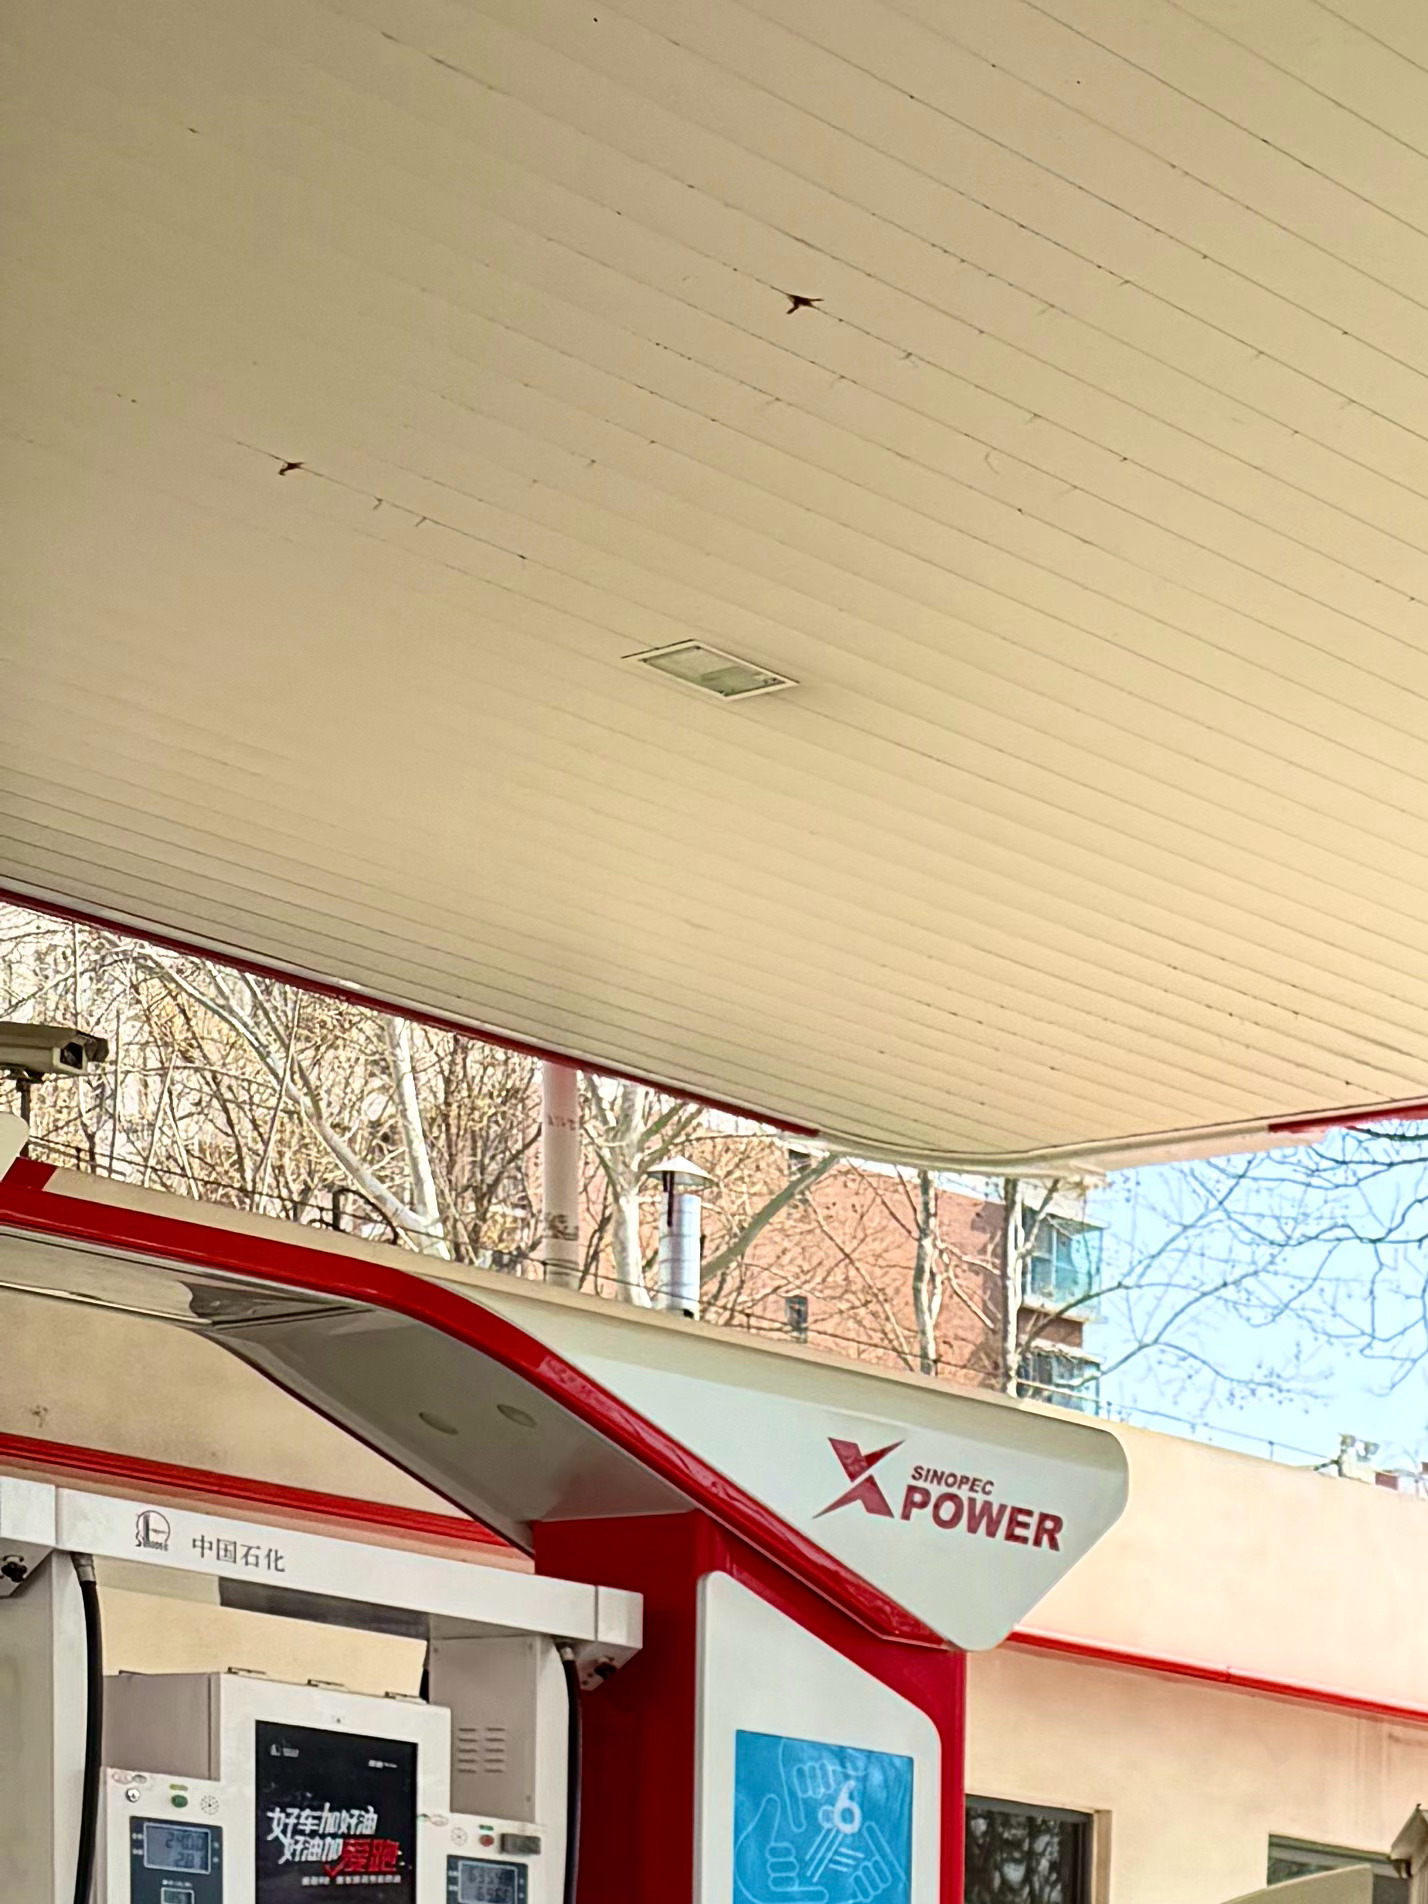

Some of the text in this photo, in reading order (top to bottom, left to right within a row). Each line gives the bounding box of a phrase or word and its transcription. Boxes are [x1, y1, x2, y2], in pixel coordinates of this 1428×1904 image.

[911, 1465, 995, 1496] SINOPEC
[900, 1484, 1064, 1552] POWER
[192, 1534, 286, 1572] 中国石化
[266, 1802, 379, 1841] 好车加好油
